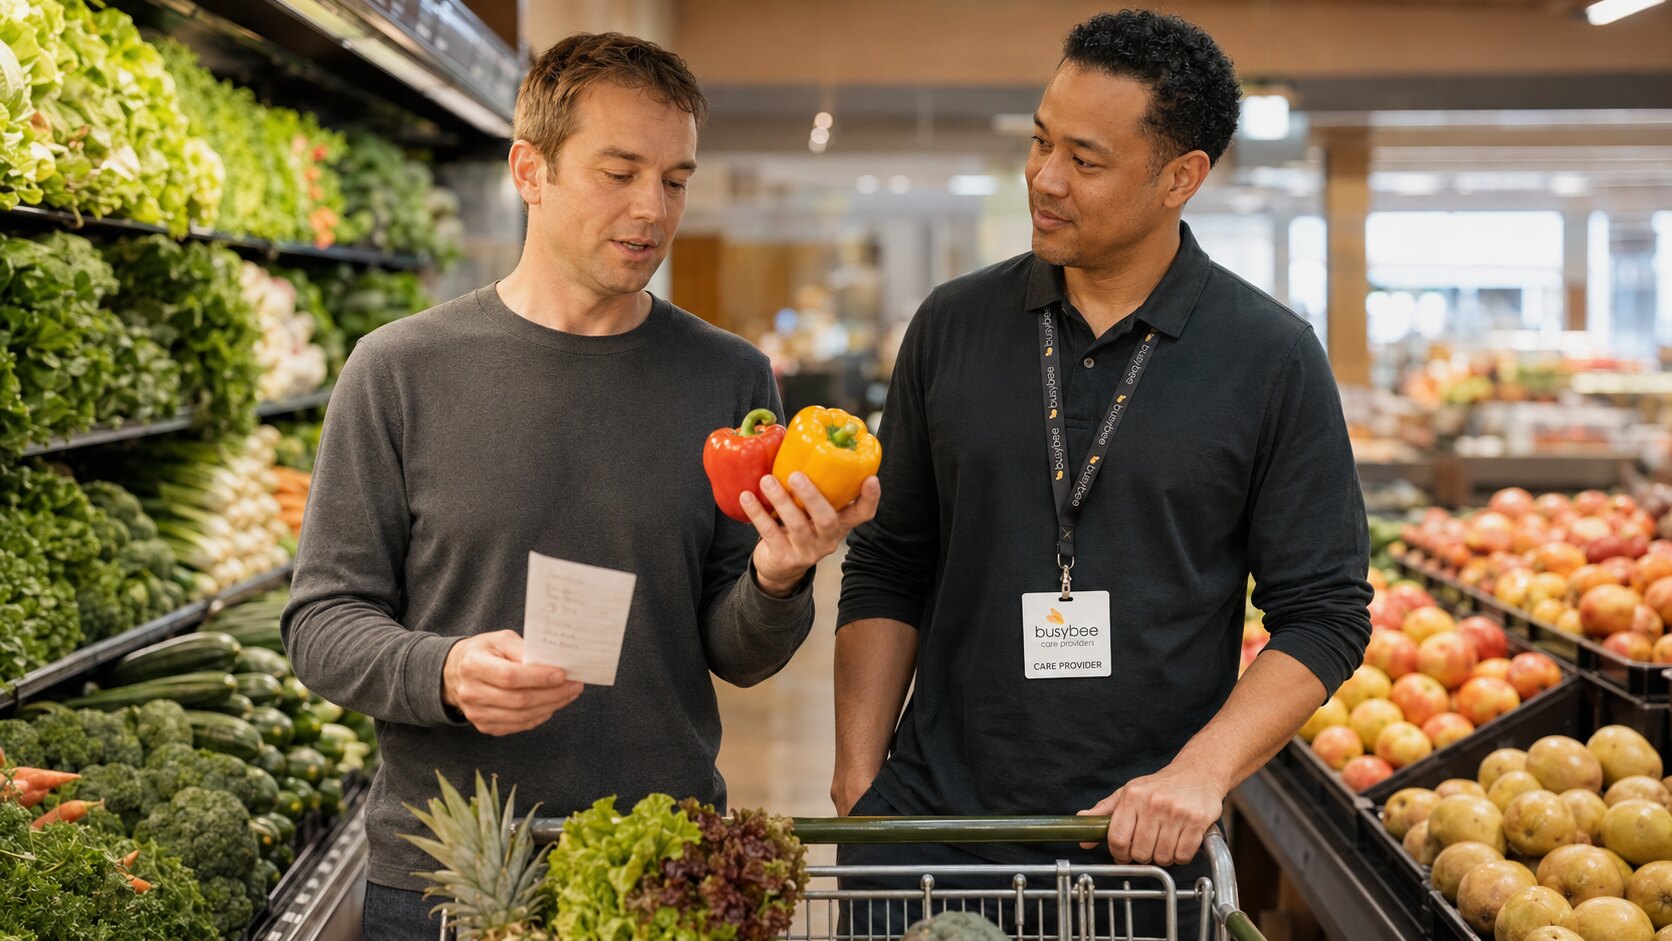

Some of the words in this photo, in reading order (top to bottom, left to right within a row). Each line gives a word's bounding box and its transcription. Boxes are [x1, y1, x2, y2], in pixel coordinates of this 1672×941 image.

[1126, 344, 1150, 385] busybee
[1046, 366, 1058, 409] busybee
[1098, 403, 1124, 445] busybee
[1051, 427, 1064, 470] busybee
[1072, 464, 1096, 507] busybee
[1035, 625, 1099, 640] busybee
[1060, 640, 1095, 649] providers
[1033, 662, 1057, 671] CARE
[1059, 661, 1102, 670] PROVIDER
